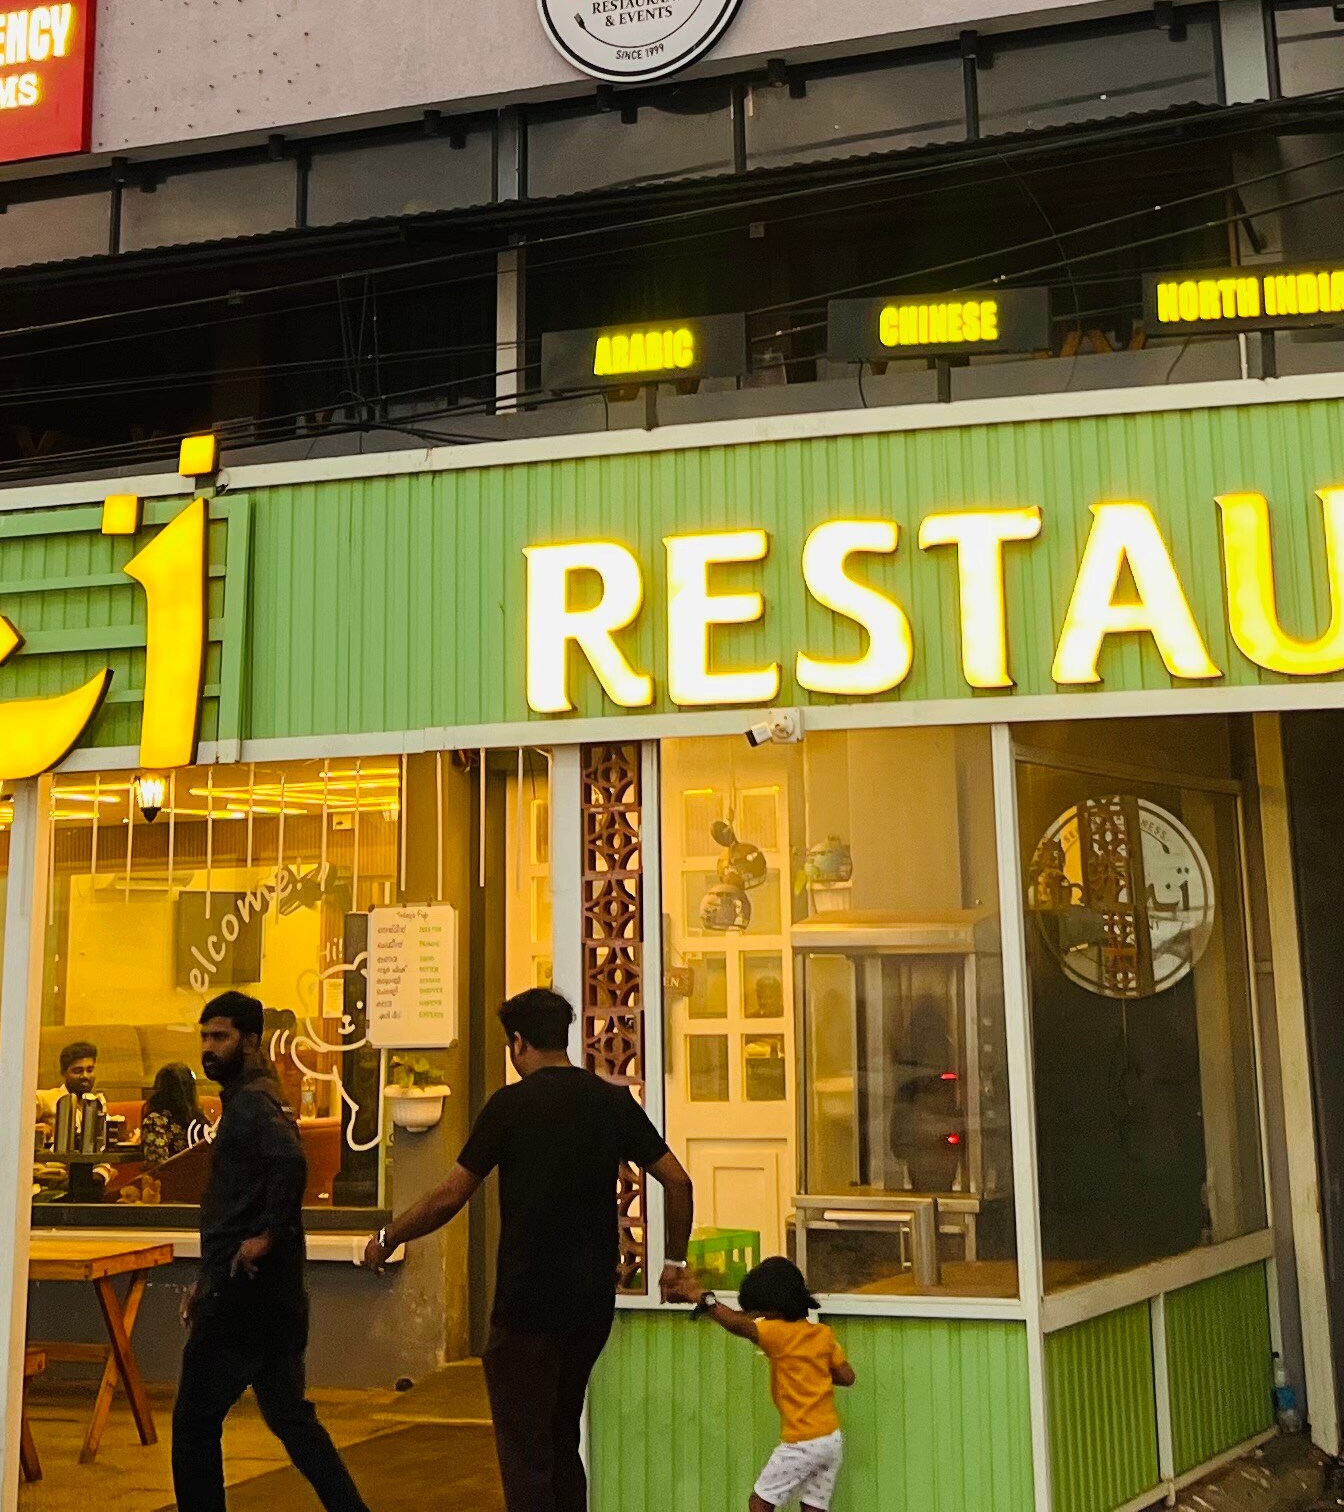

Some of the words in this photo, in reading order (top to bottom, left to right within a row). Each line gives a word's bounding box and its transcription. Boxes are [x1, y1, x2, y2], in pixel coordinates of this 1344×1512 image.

[605, 15, 615, 27] &
[619, 5, 673, 25] EVENTS
[615, 48, 643, 60] SINCE
[645, 43, 664, 58] 1999
[1157, 276, 1260, 323] NORTH
[879, 301, 999, 348] CHINESE
[593, 328, 694, 376] ARABIC
[175, 857, 303, 1006] elcome!
